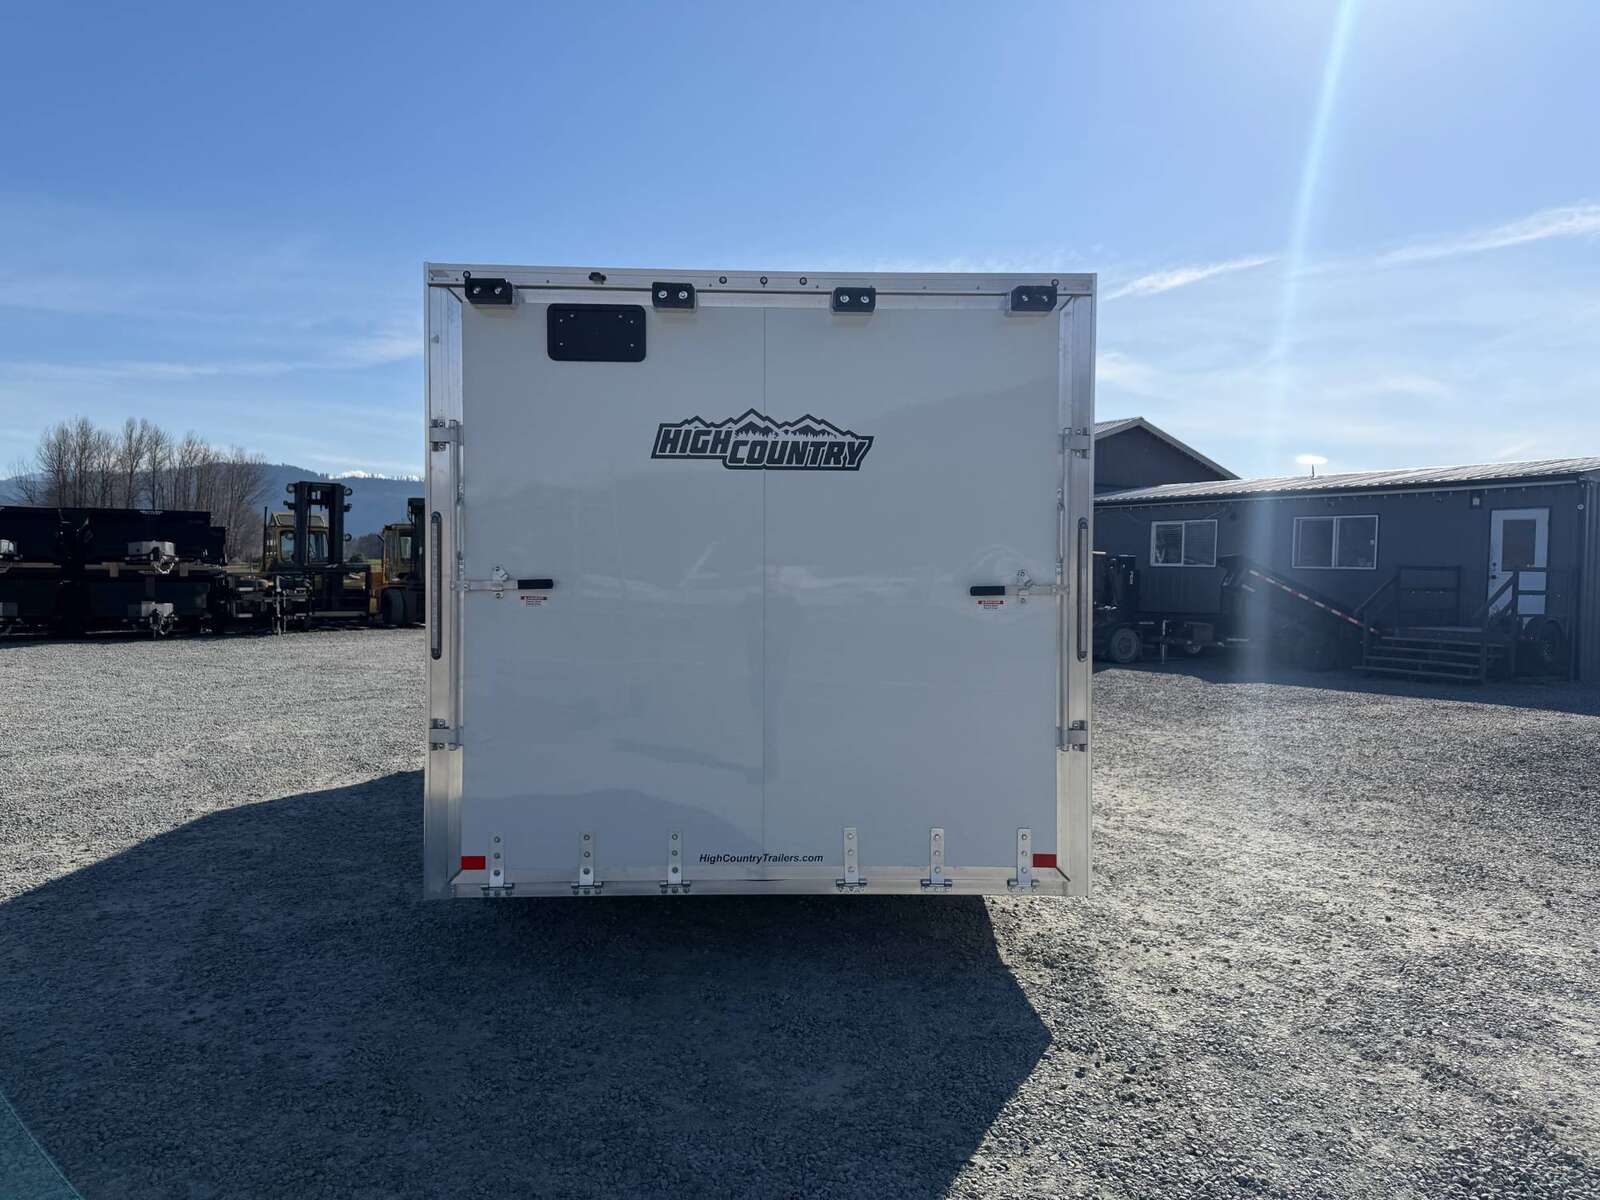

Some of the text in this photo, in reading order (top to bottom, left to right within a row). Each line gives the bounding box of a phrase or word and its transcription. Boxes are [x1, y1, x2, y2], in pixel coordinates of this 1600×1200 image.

[656, 428, 866, 465] HIGH COUNTRY
[699, 853, 824, 865] HighCountryTrailers.com
